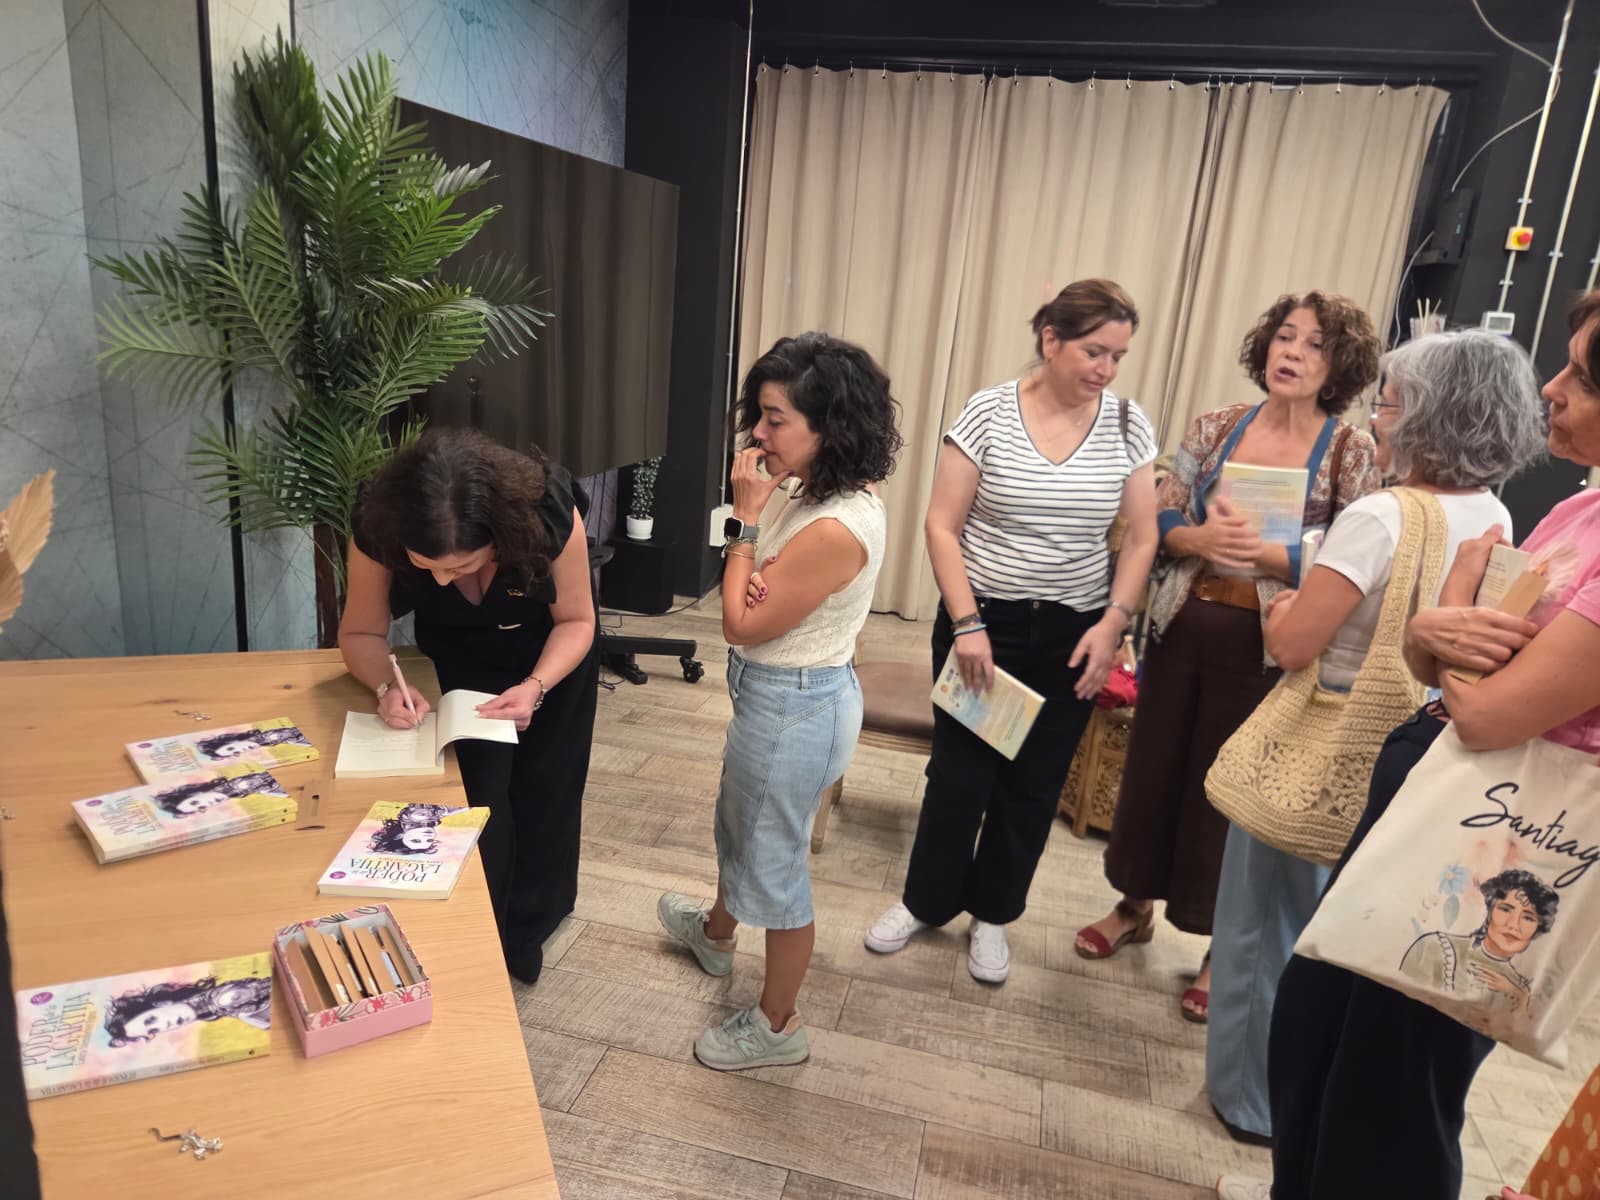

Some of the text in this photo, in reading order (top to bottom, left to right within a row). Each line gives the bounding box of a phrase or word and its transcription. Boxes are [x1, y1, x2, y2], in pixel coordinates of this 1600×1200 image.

[350, 858, 441, 874] LAGARTIJA
[366, 868, 426, 882] PODER
[21, 1015, 60, 1067] PODER
[46, 991, 94, 1071] LAGARTIJA
